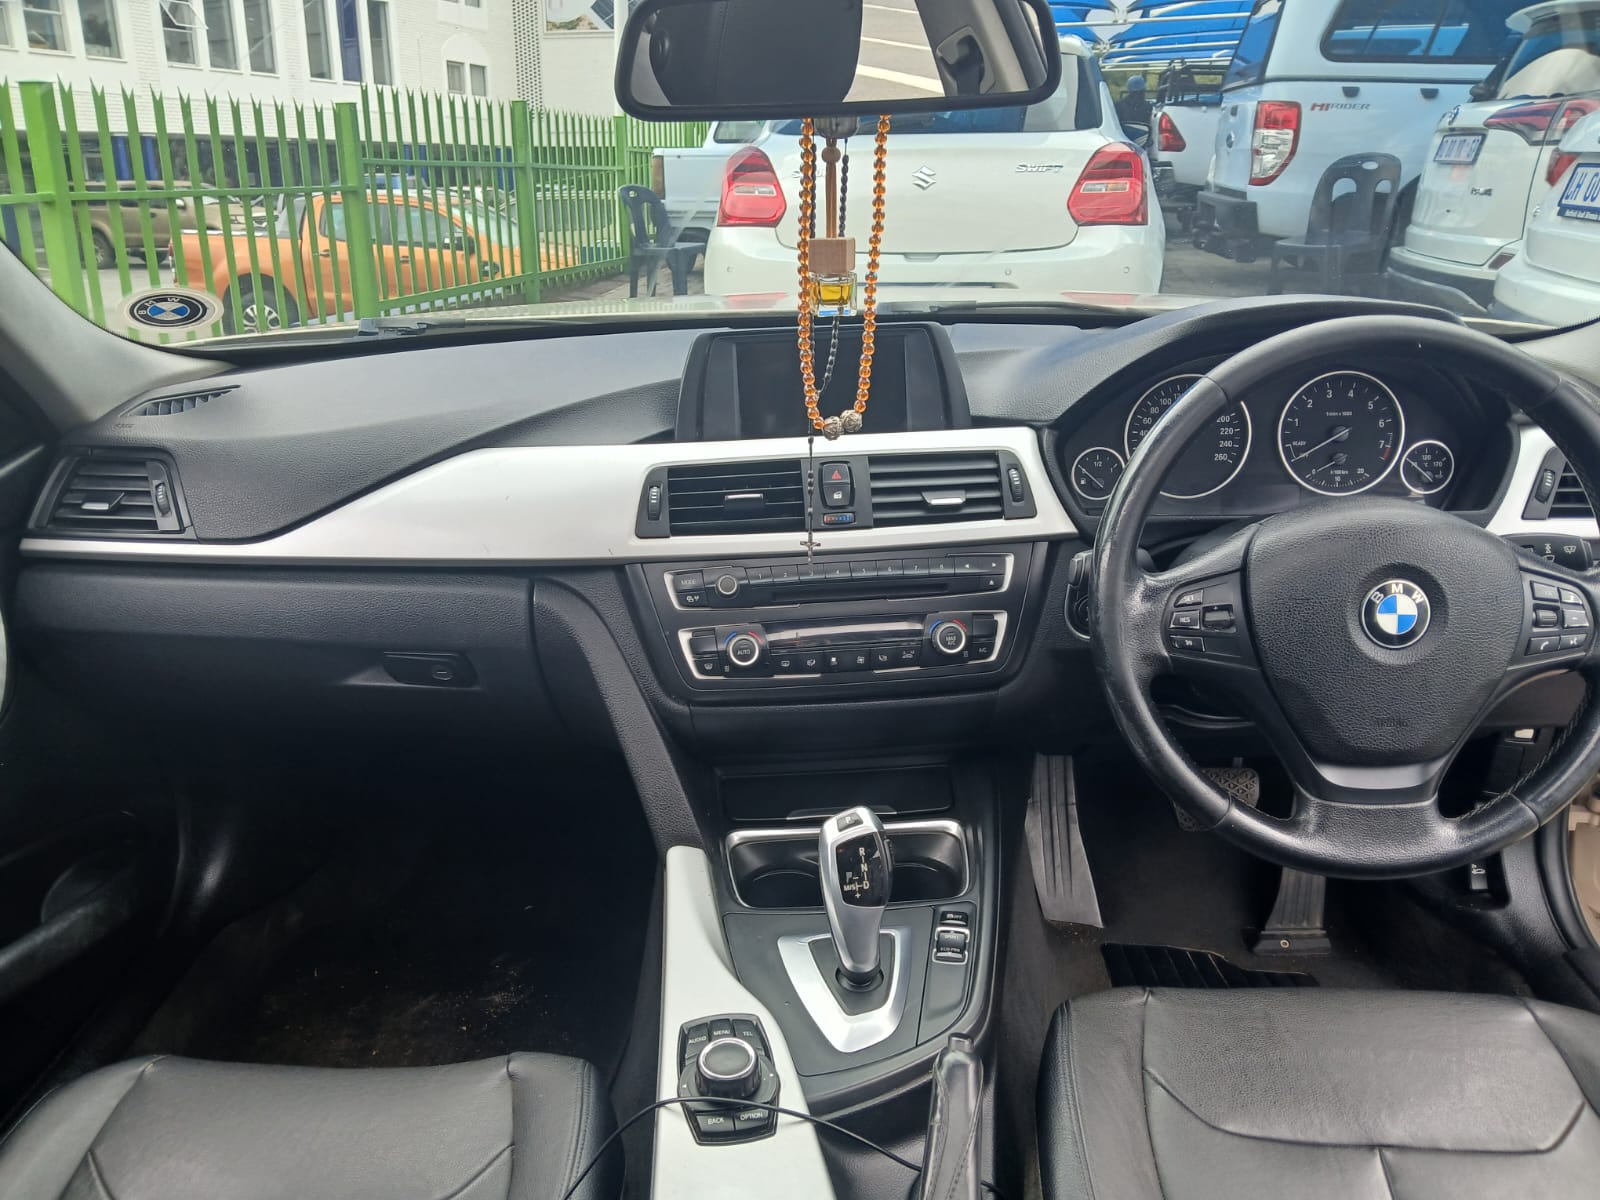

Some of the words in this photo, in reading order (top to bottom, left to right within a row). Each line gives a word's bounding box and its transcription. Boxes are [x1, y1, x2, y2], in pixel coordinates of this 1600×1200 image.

[1015, 163, 1065, 173] SWIFT
[137, 297, 181, 315] BMW
[1326, 389, 1333, 399] 3
[1347, 389, 1354, 399] 4
[1160, 398, 1172, 407] 100
[1307, 399, 1313, 409] 2
[1368, 400, 1375, 410] 5
[1150, 406, 1160, 414] 80
[1142, 417, 1153, 425] 60
[1217, 414, 1231, 423] 200
[1294, 417, 1300, 428] 1
[1378, 418, 1385, 428] 6
[1220, 427, 1234, 436] 220
[1219, 440, 1233, 448] 240
[1379, 440, 1385, 450] 7
[1214, 453, 1228, 462] 260
[1370, 583, 1424, 604] BMW
[845, 816, 851, 824] P
[858, 847, 866, 857] R
[861, 863, 869, 872] N
[863, 880, 870, 890] D
[688, 1035, 707, 1044] AUDIO
[739, 1112, 764, 1121] OPTION
[707, 1117, 725, 1126] BACK
